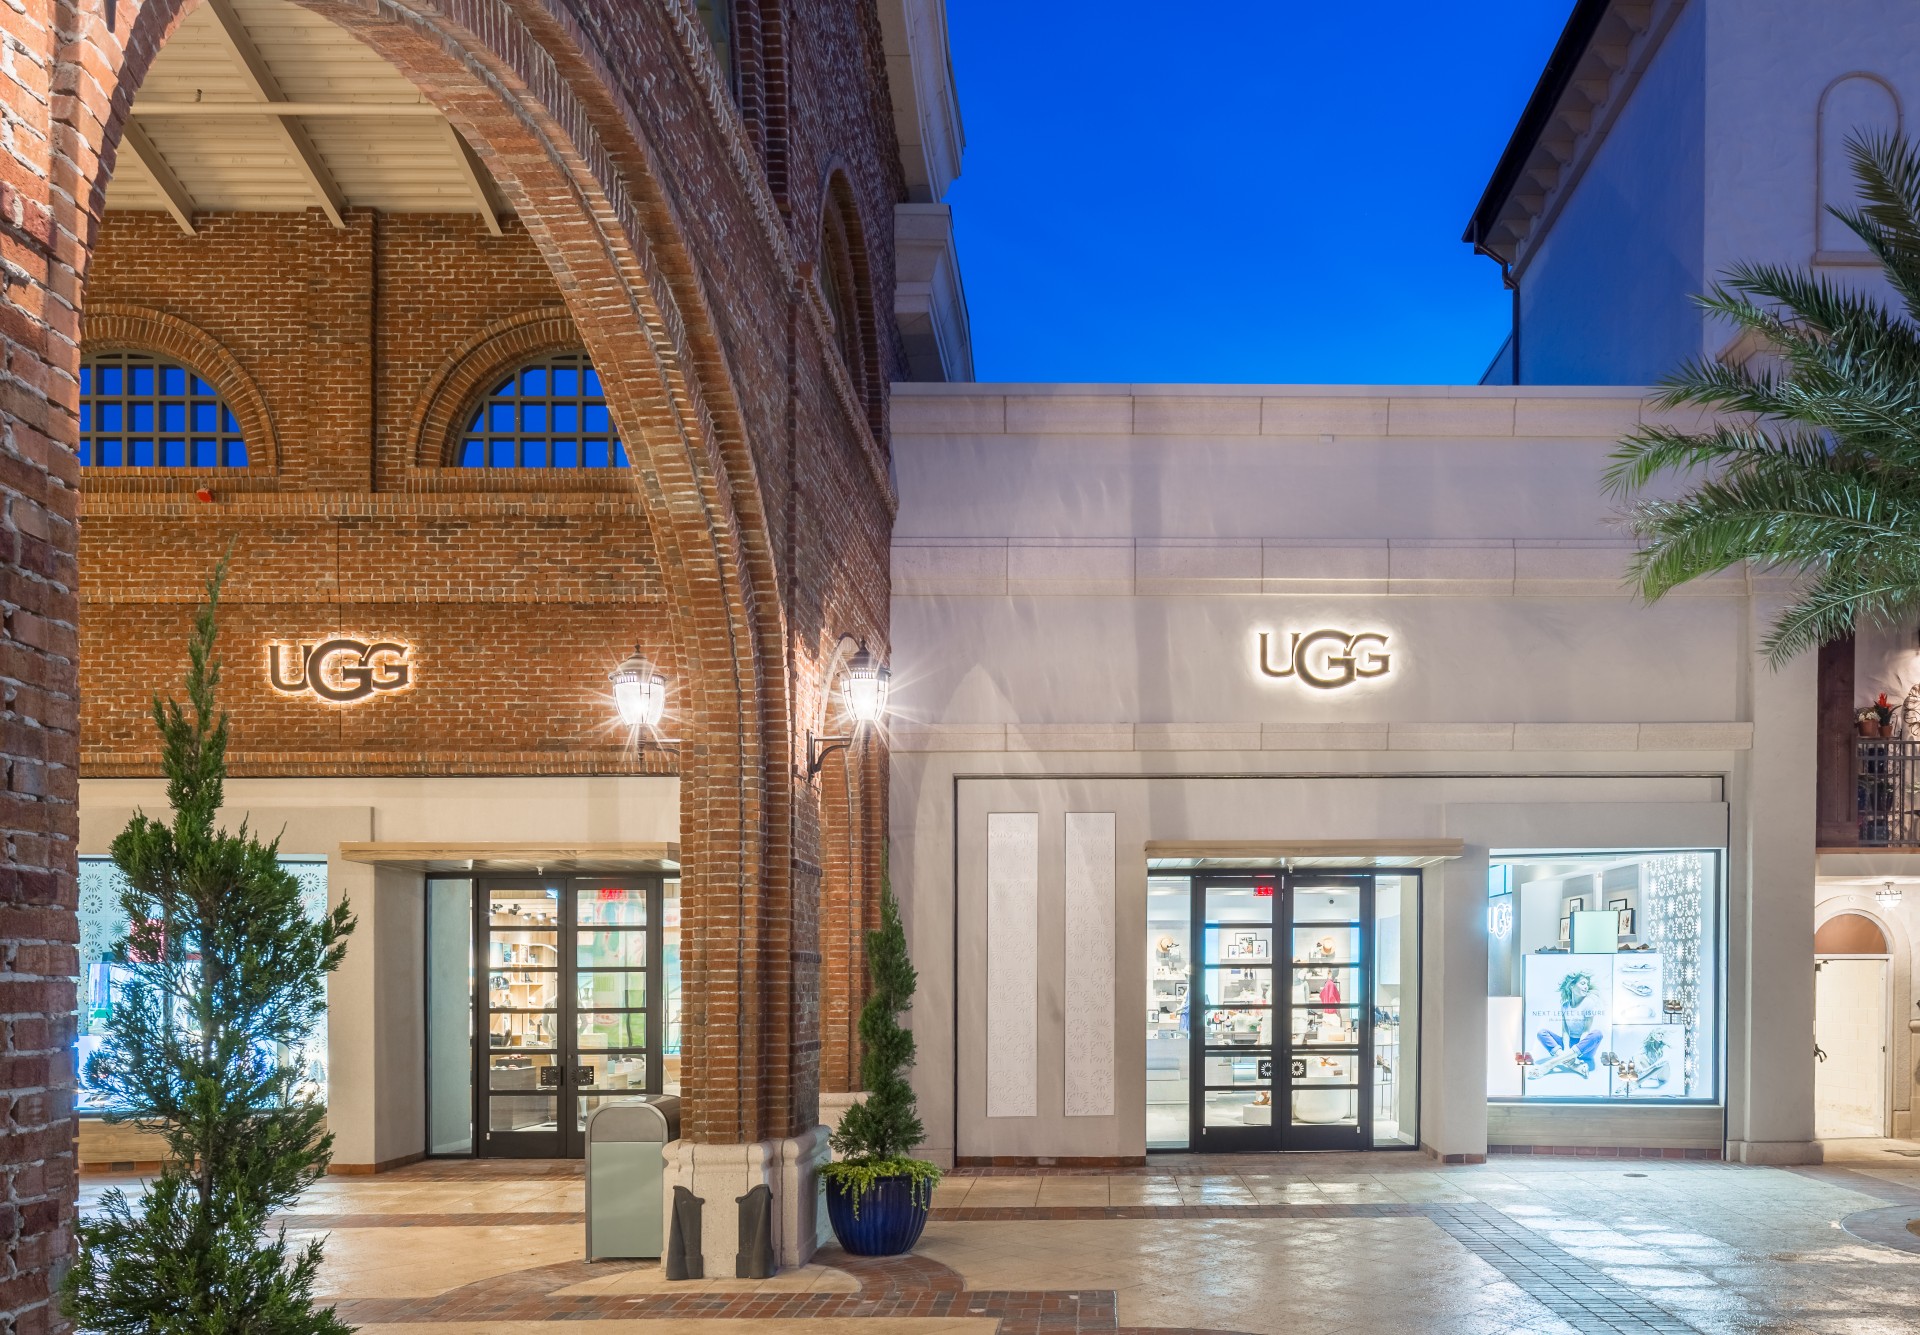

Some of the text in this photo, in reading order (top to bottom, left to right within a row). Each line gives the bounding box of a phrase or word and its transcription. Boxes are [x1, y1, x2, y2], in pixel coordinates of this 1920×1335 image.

[269, 640, 409, 701] UGG
[1258, 629, 1391, 689] UGG
[1487, 903, 1512, 939] UGG
